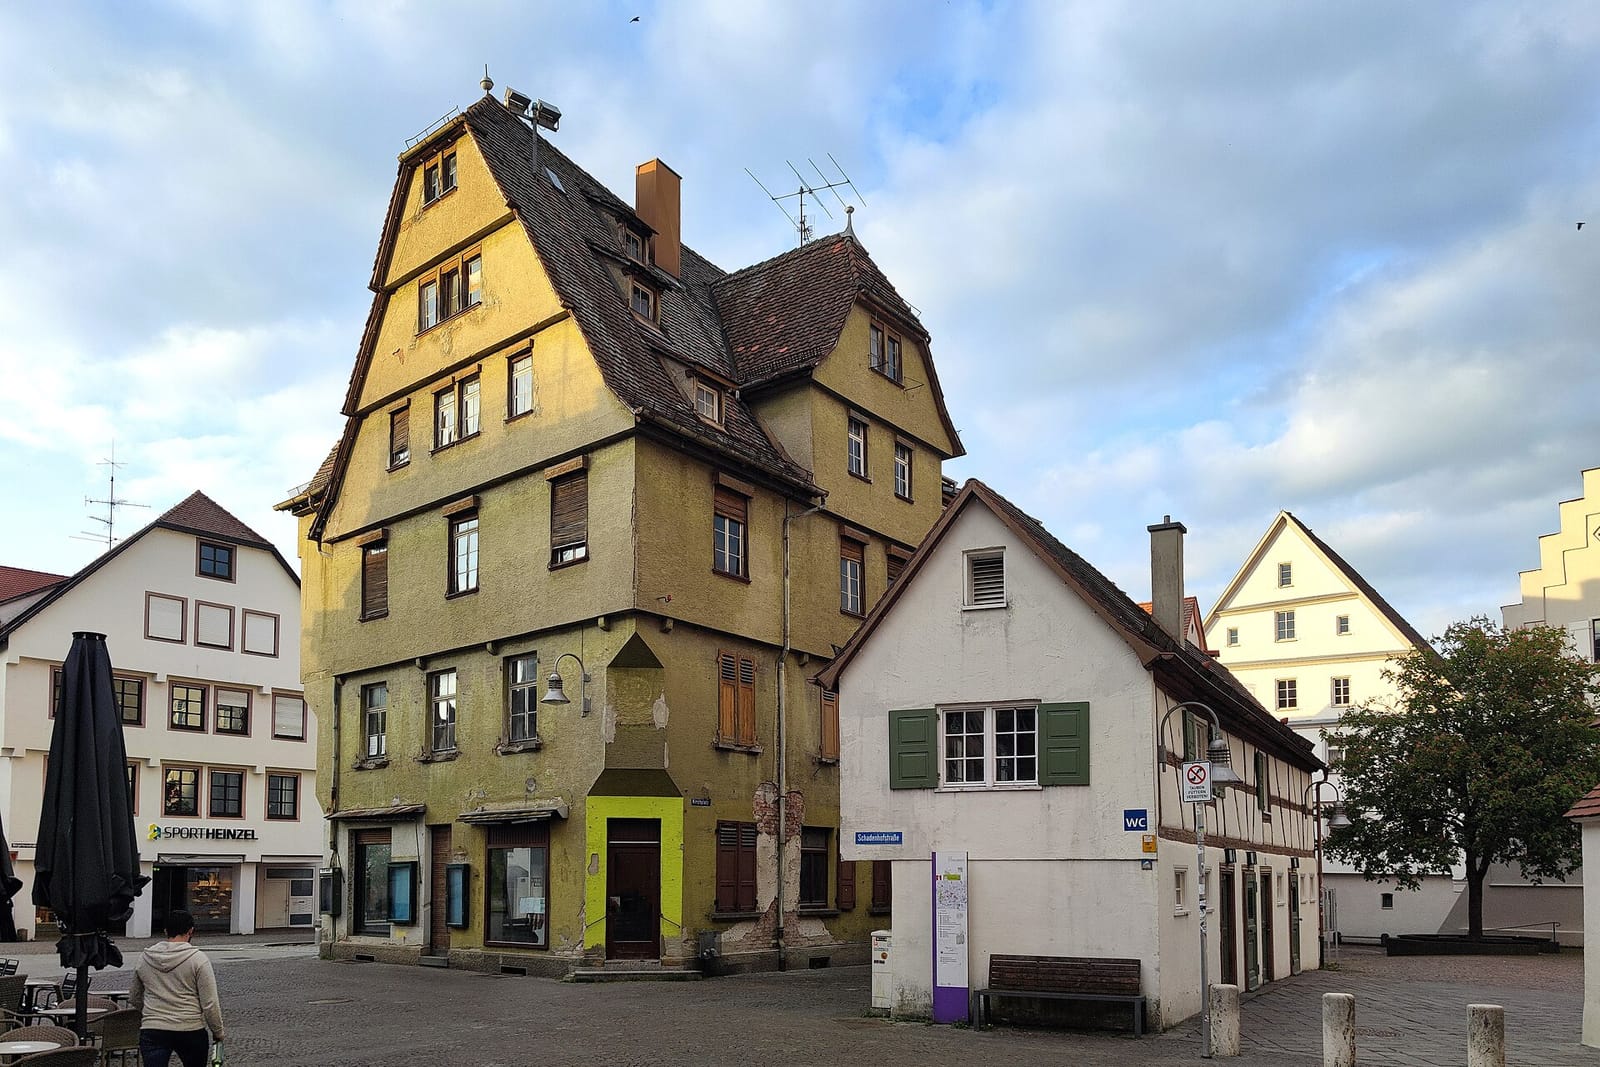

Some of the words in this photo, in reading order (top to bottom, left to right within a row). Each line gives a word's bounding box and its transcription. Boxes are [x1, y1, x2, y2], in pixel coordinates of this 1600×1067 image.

[1125, 817, 1146, 828] WC
[164, 826, 258, 841] SPORTHEINZEL
[857, 833, 900, 842] Schadenhofstraße
